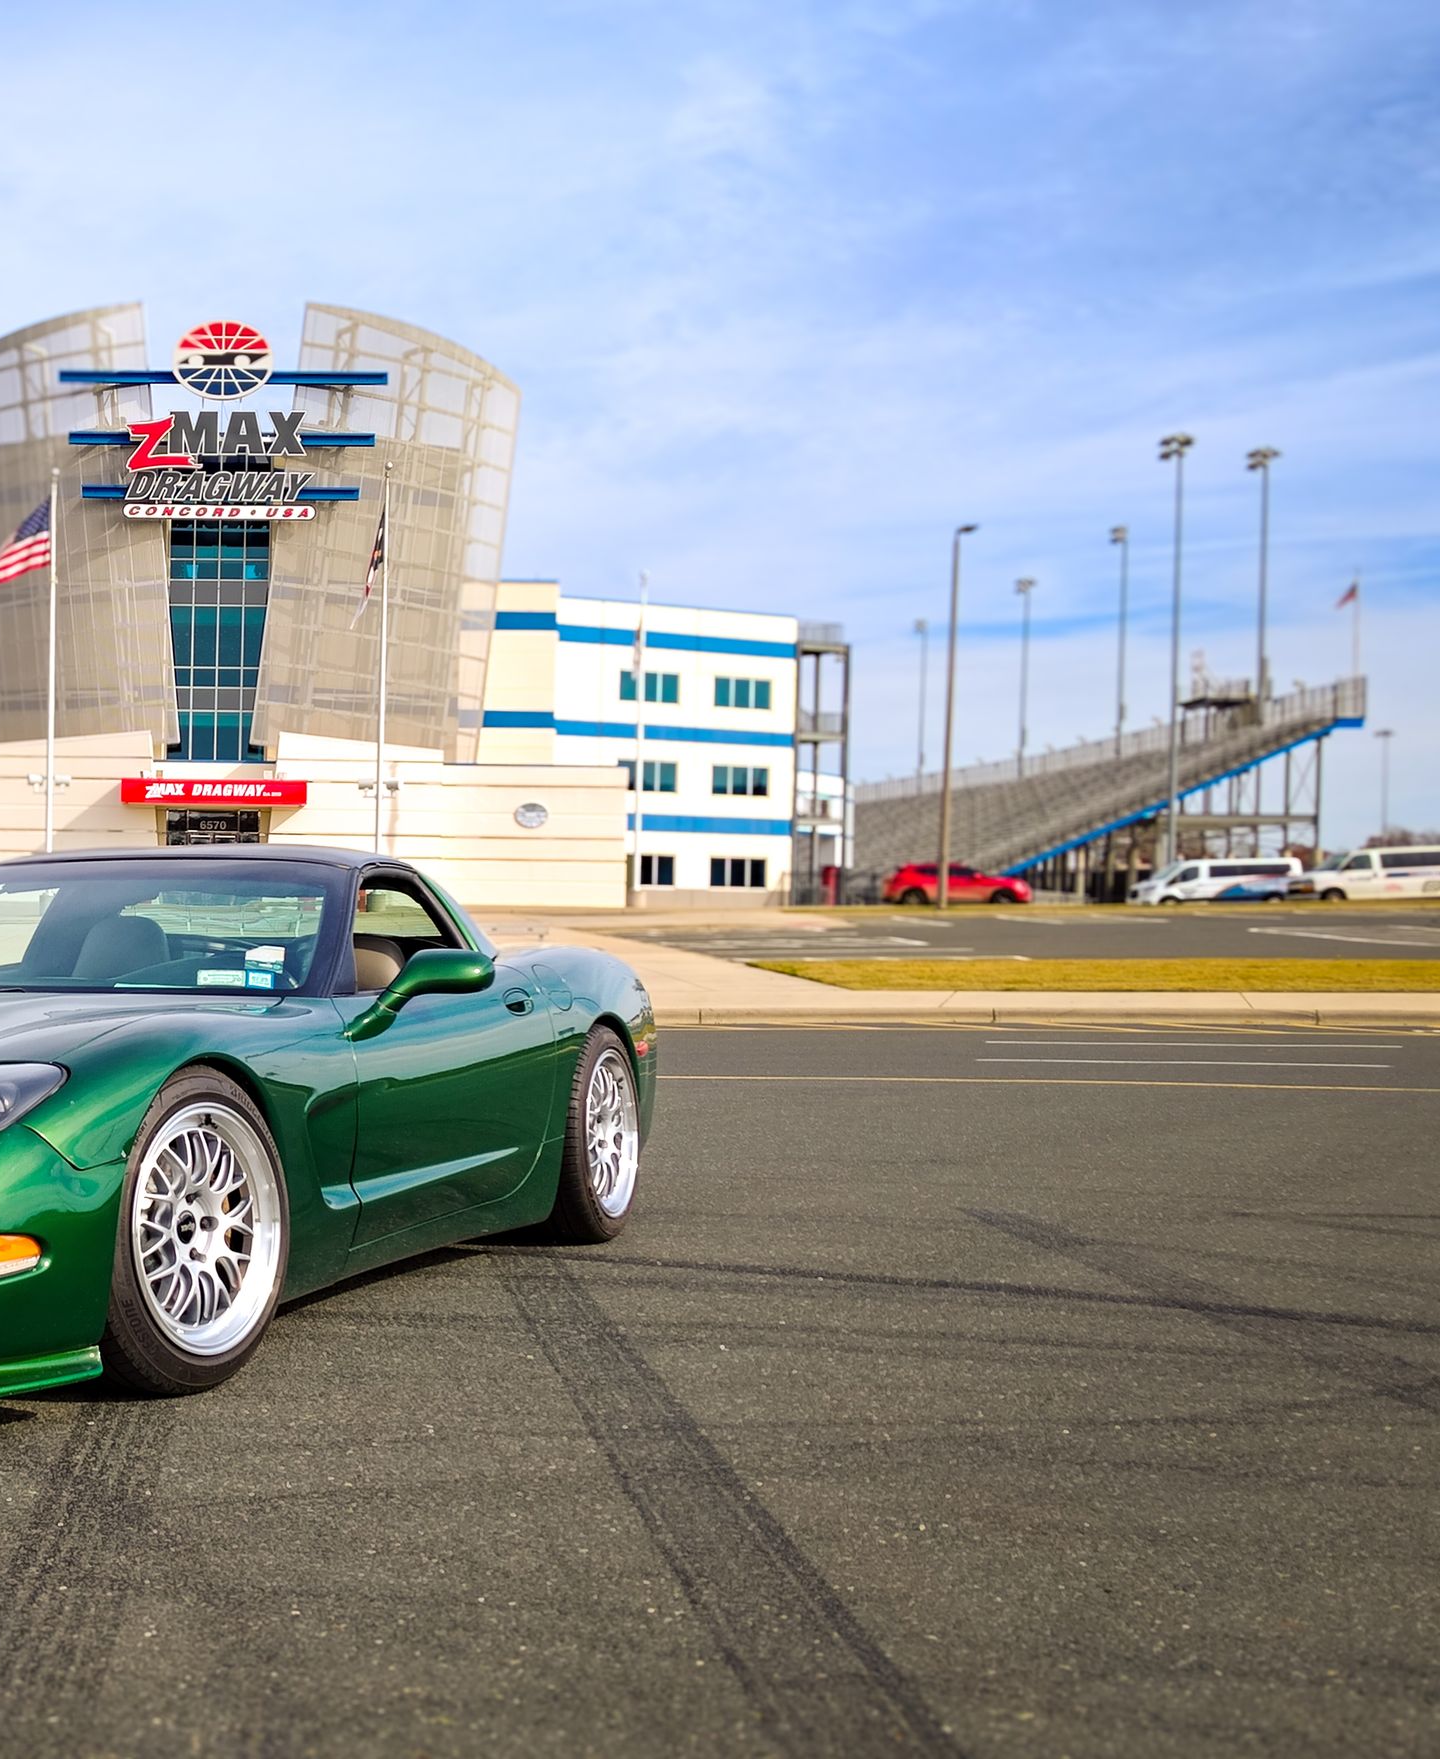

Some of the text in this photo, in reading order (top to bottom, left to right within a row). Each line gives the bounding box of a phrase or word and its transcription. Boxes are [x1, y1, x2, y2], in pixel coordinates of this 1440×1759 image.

[125, 470, 316, 502] DRAGWAY
[128, 506, 309, 518] CONCORD USA
[191, 783, 266, 797] DRAGWAY
[200, 821, 227, 830] 6570
